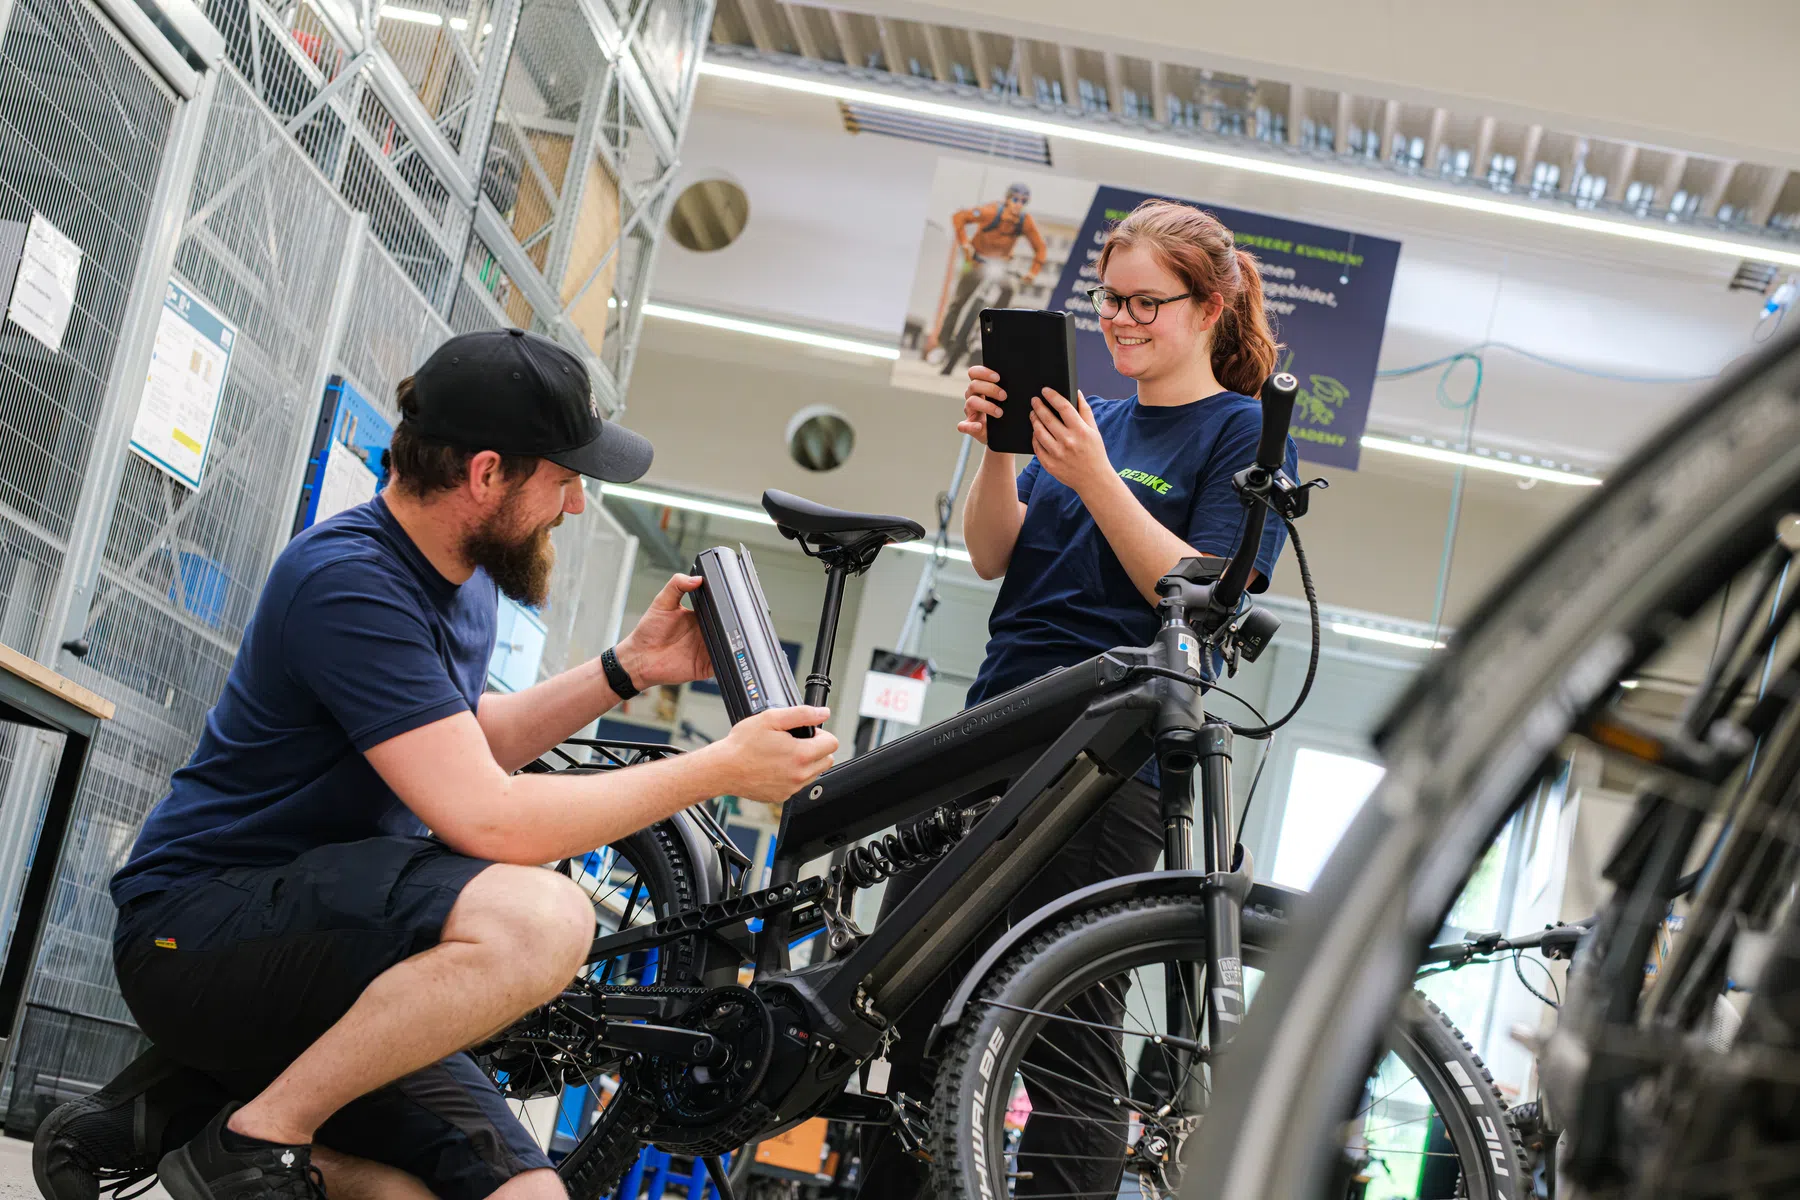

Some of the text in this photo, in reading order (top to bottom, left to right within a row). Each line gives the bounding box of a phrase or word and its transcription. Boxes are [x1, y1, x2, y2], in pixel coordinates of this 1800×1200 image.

[1118, 468, 1173, 495] REBIKE
[980, 697, 1031, 726] NICOLAI
[971, 1026, 1006, 1200] HWALBE
